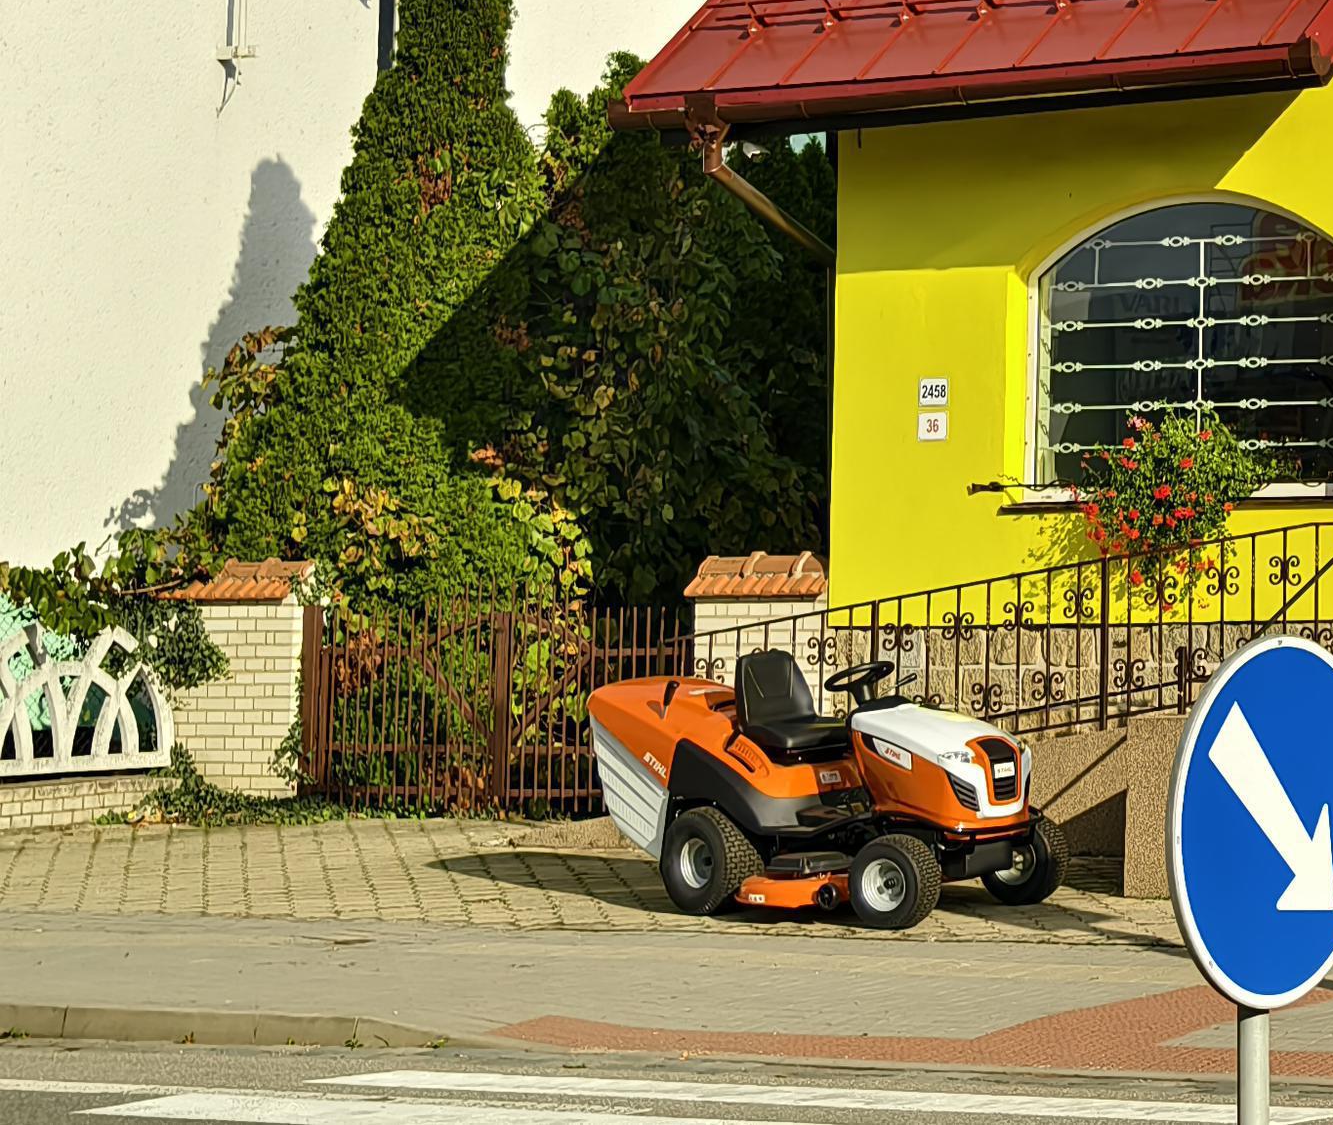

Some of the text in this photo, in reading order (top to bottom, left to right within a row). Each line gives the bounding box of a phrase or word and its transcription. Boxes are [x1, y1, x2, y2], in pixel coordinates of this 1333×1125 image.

[921, 384, 947, 399] 2458
[926, 418, 939, 433] 36
[643, 752, 667, 779] STIHL
